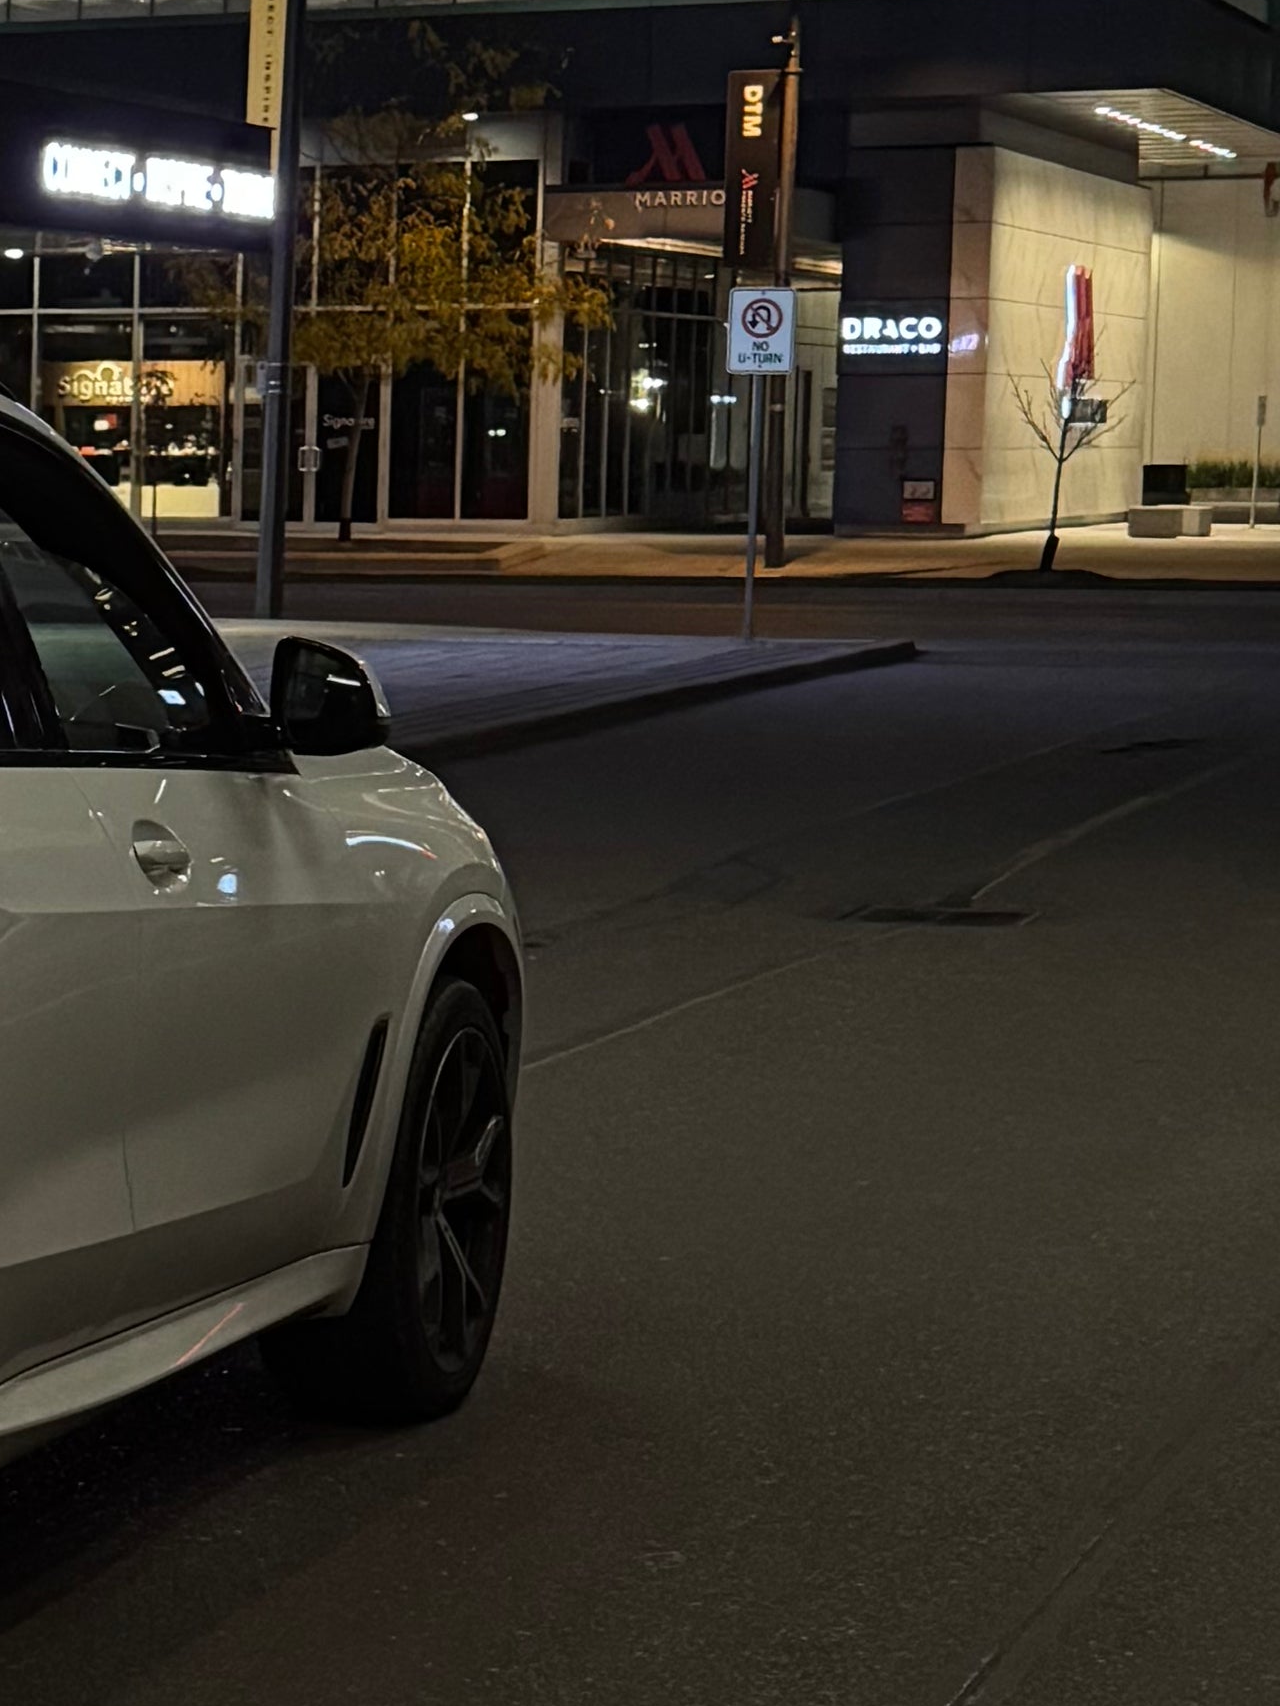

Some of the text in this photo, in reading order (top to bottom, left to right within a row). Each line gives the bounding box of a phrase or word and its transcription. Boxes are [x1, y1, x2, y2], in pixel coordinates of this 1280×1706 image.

[742, 85, 764, 137] DTM
[841, 316, 942, 340] DRACO
[752, 341, 770, 352] NO
[738, 353, 782, 364] U-TURN
